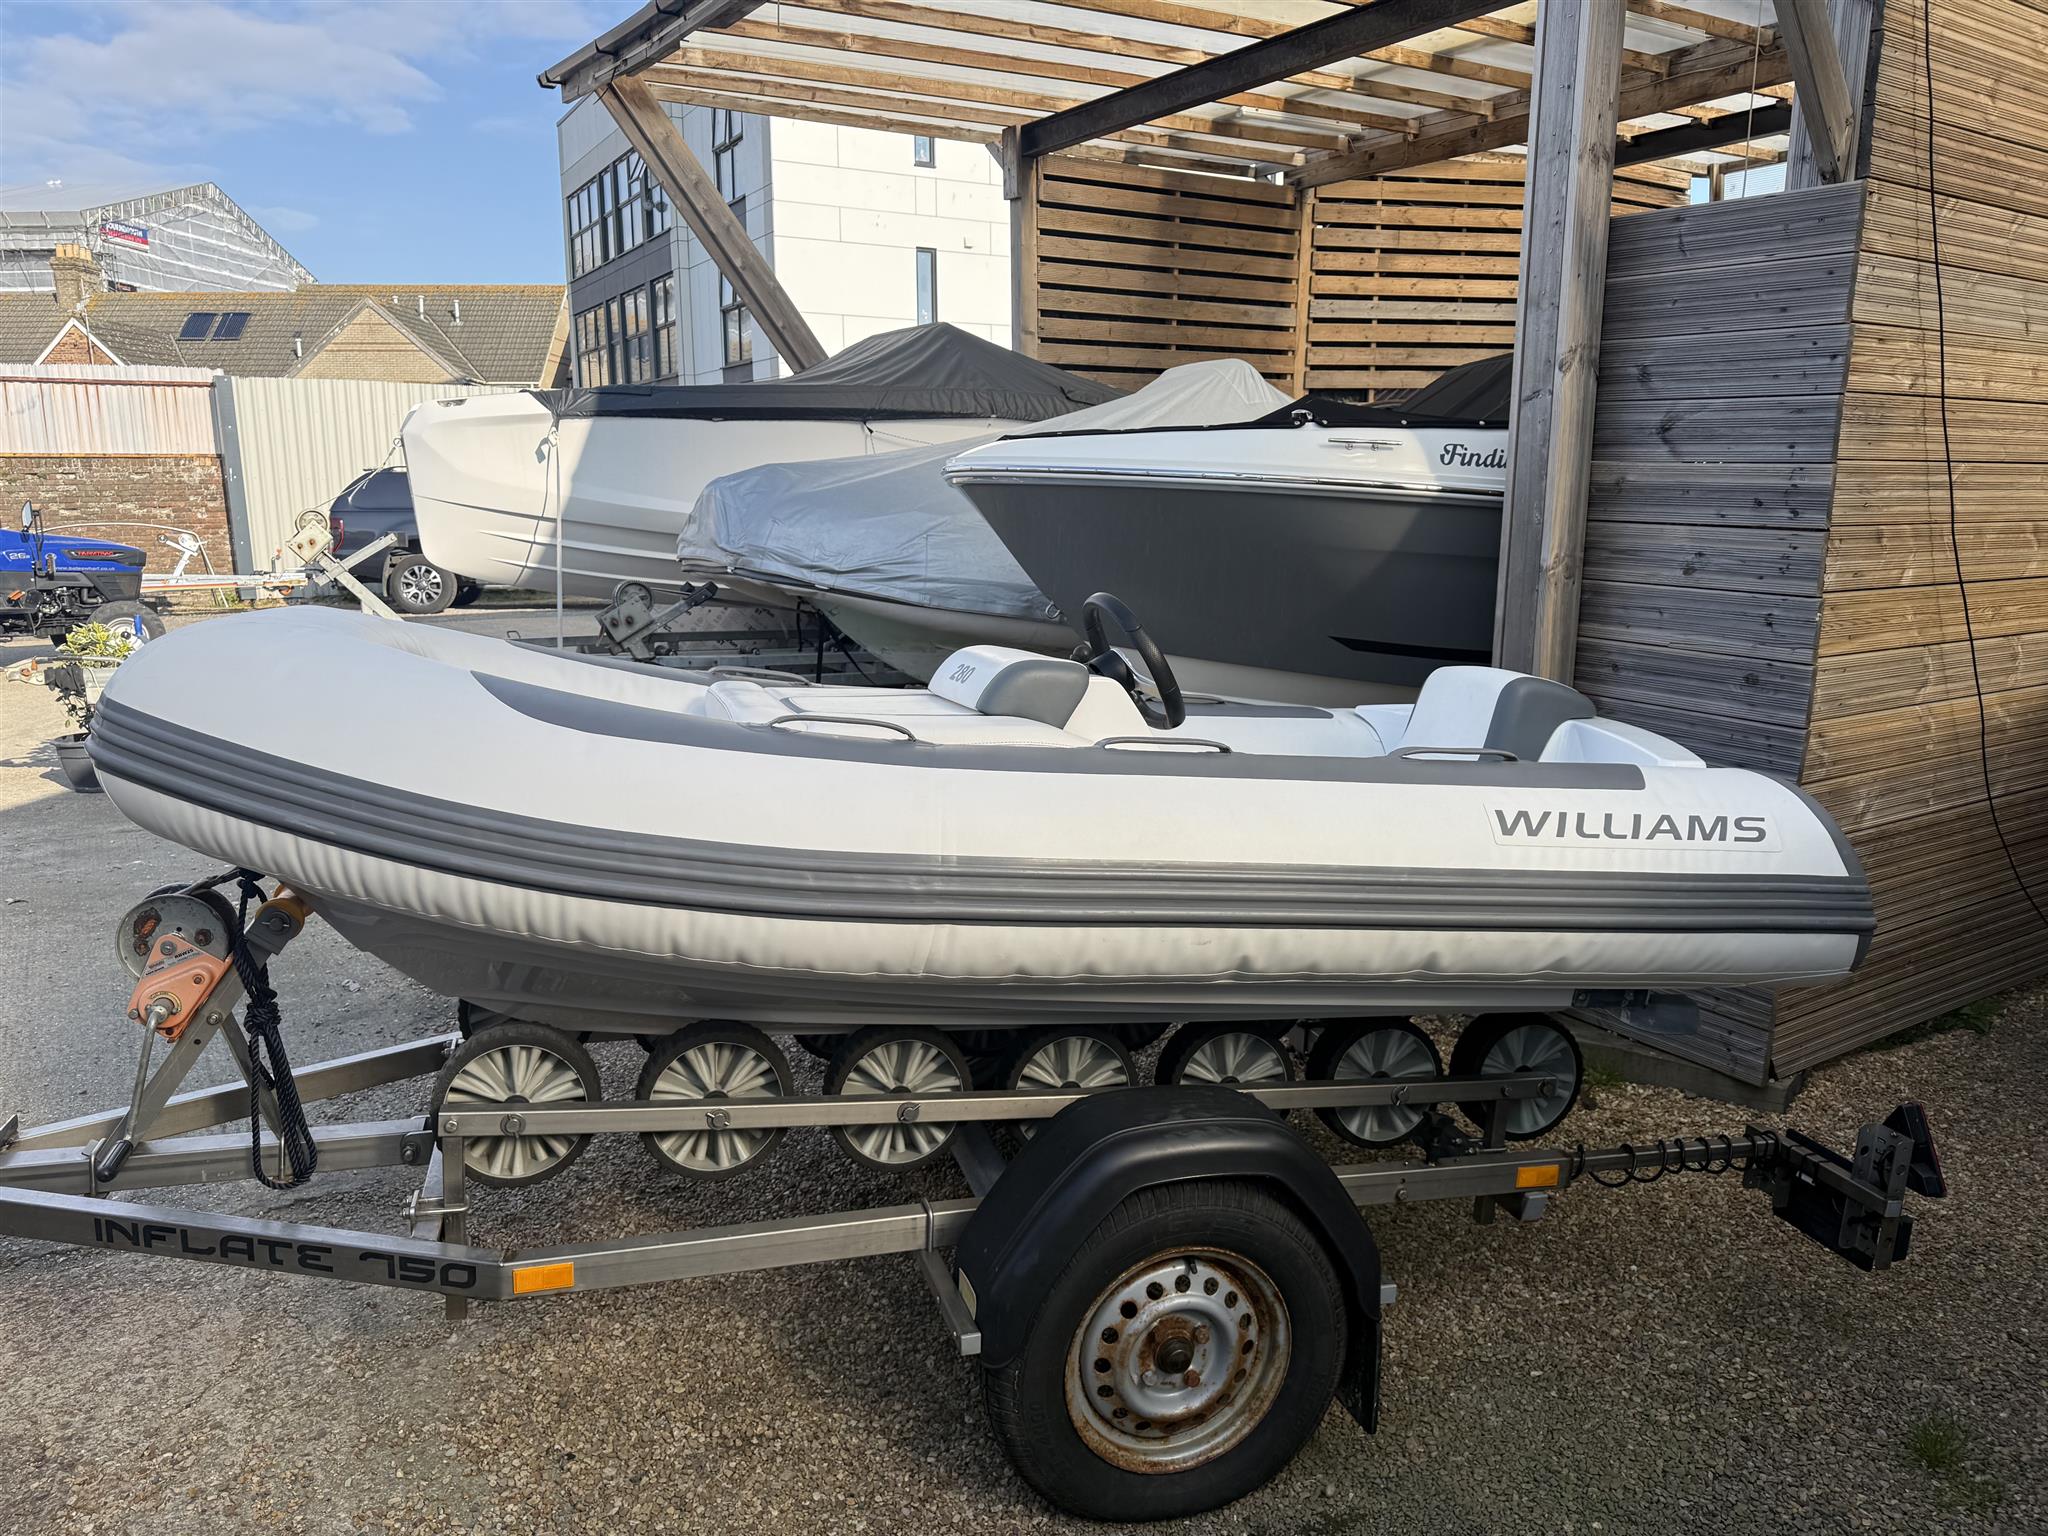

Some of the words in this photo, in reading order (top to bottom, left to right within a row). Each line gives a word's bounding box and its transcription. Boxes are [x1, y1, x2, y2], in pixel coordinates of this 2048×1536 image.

[1440, 443, 1507, 468] Findi
[949, 663, 976, 684] 280
[1494, 809, 1767, 843] WILLIAMS
[94, 1217, 334, 1273] INFLATE
[359, 1251, 477, 1289] 750
